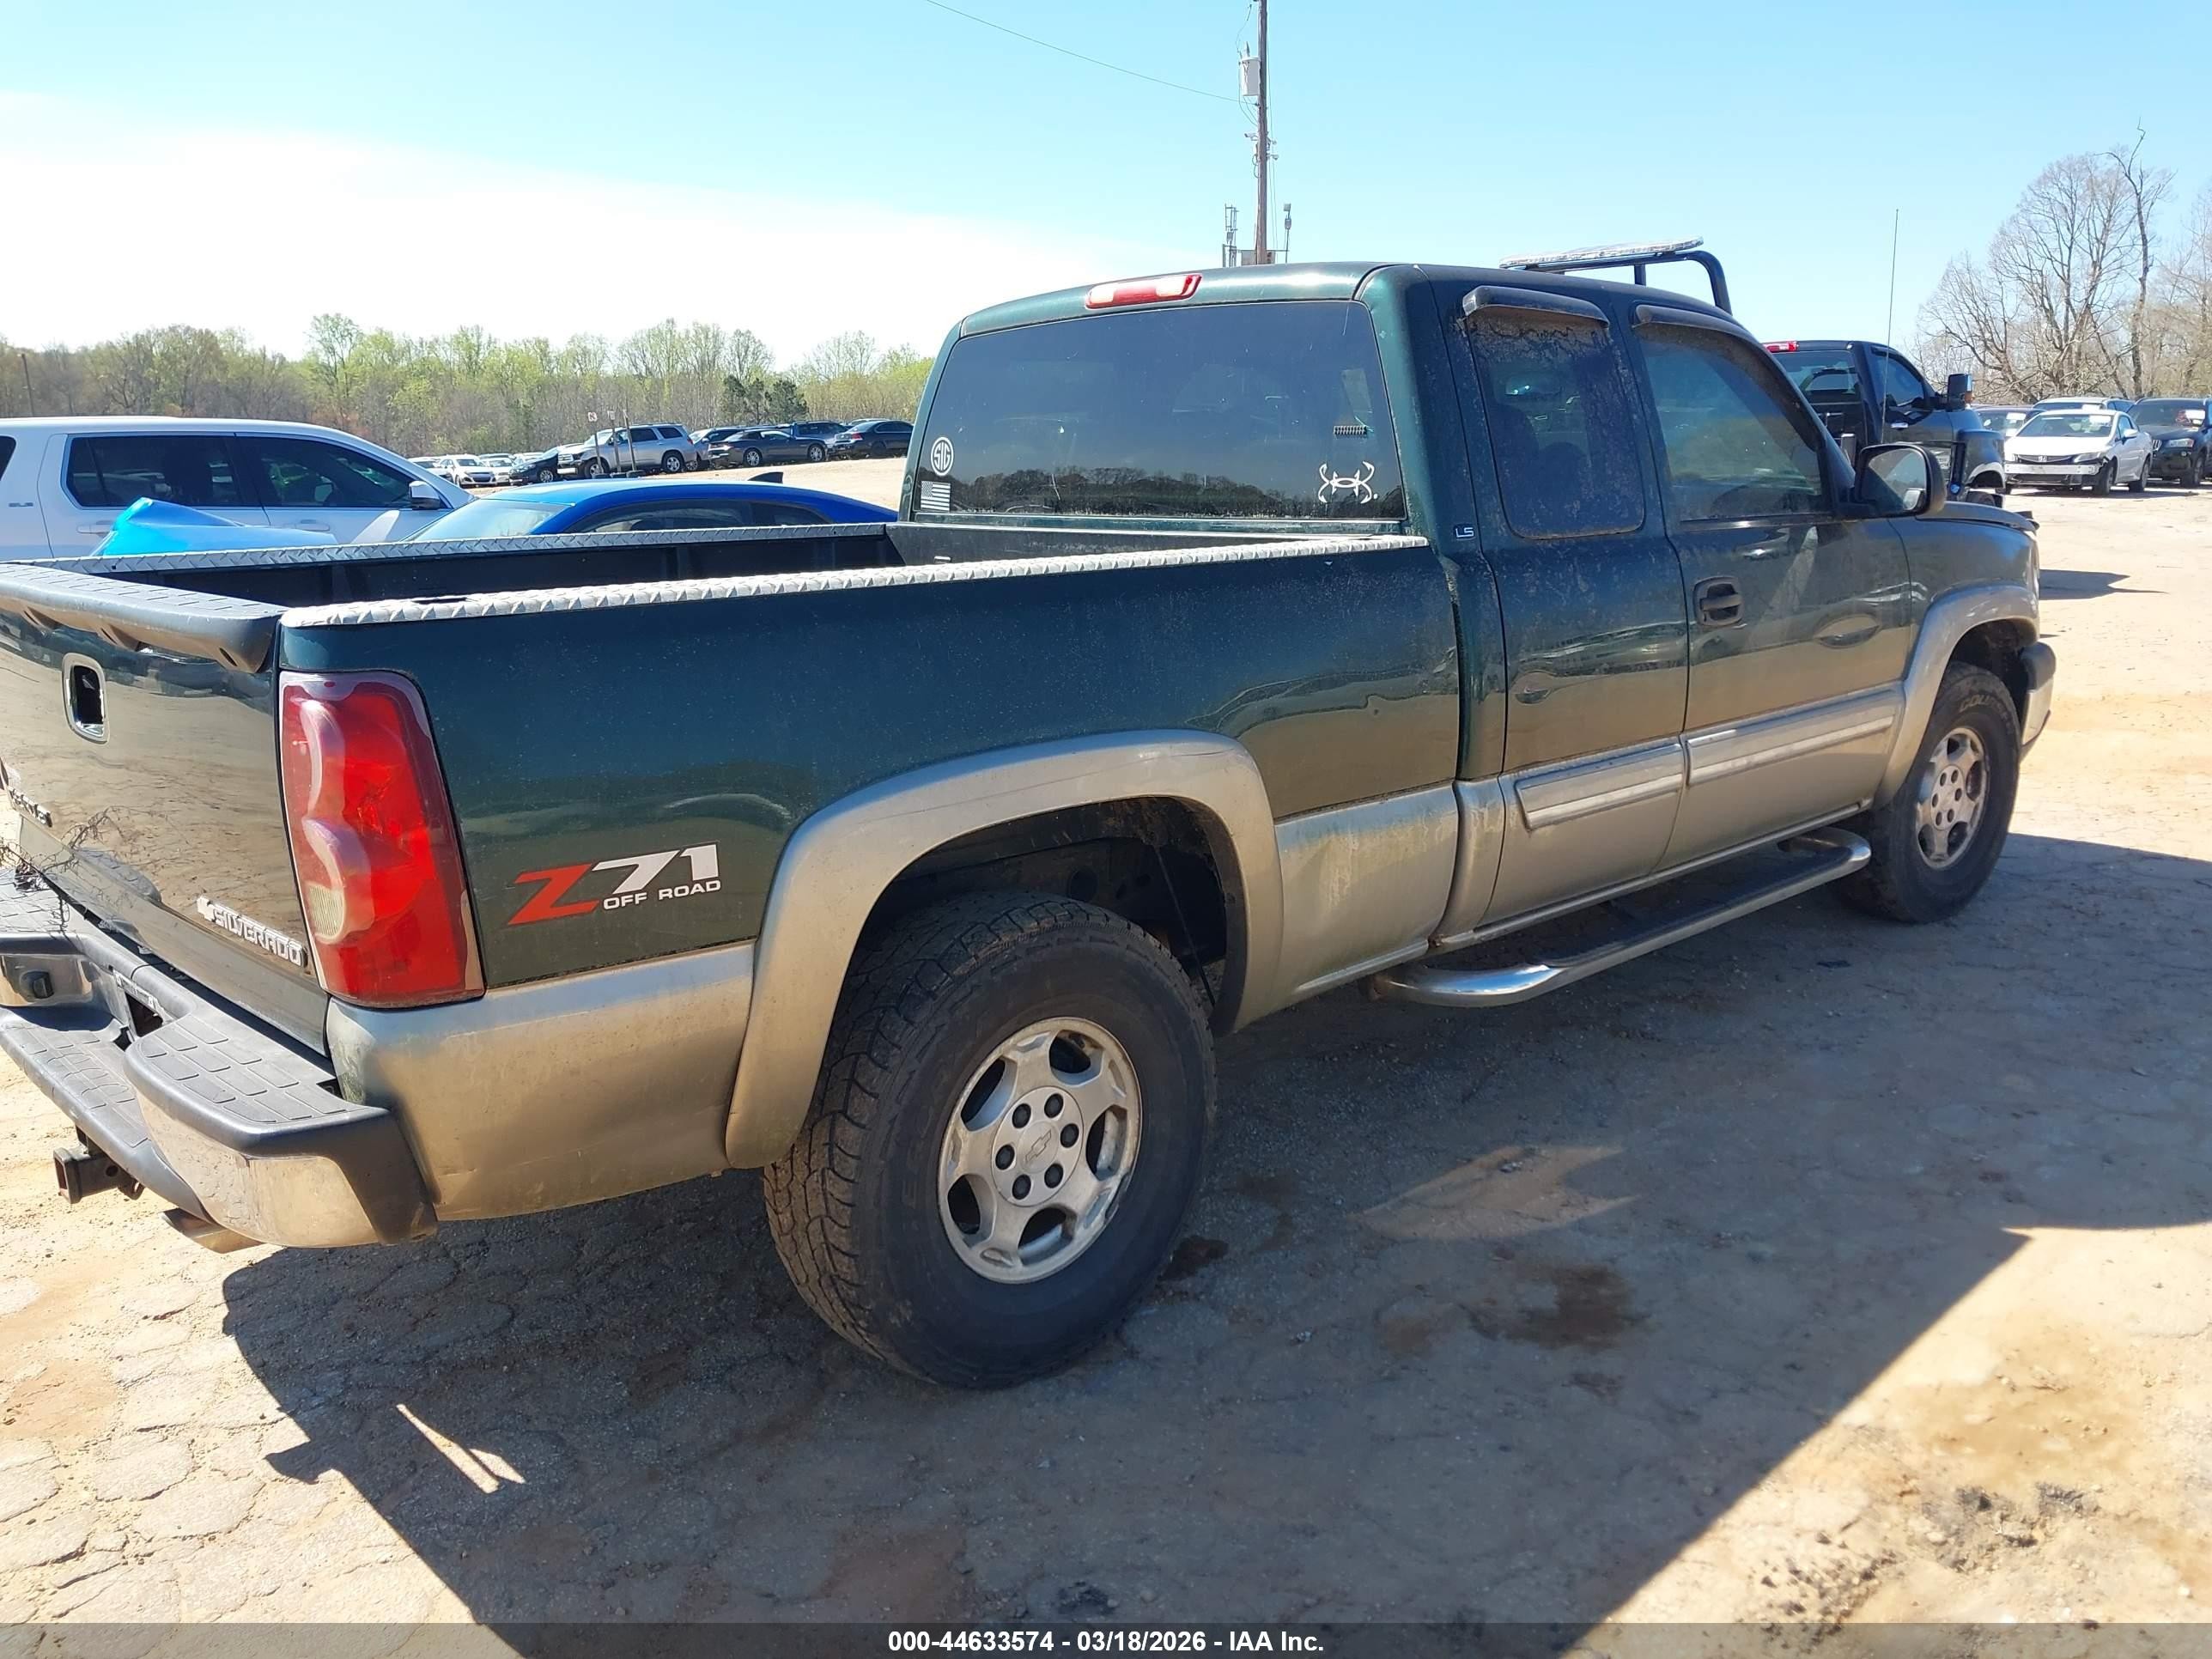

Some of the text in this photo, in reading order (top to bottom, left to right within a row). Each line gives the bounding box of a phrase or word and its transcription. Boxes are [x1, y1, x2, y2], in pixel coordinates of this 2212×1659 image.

[933, 441, 951, 471] SIG
[1455, 526, 1474, 538] LS
[507, 844, 720, 926] Z71
[603, 879, 721, 910] OFF ROAD
[212, 902, 303, 967] SILVERADO
